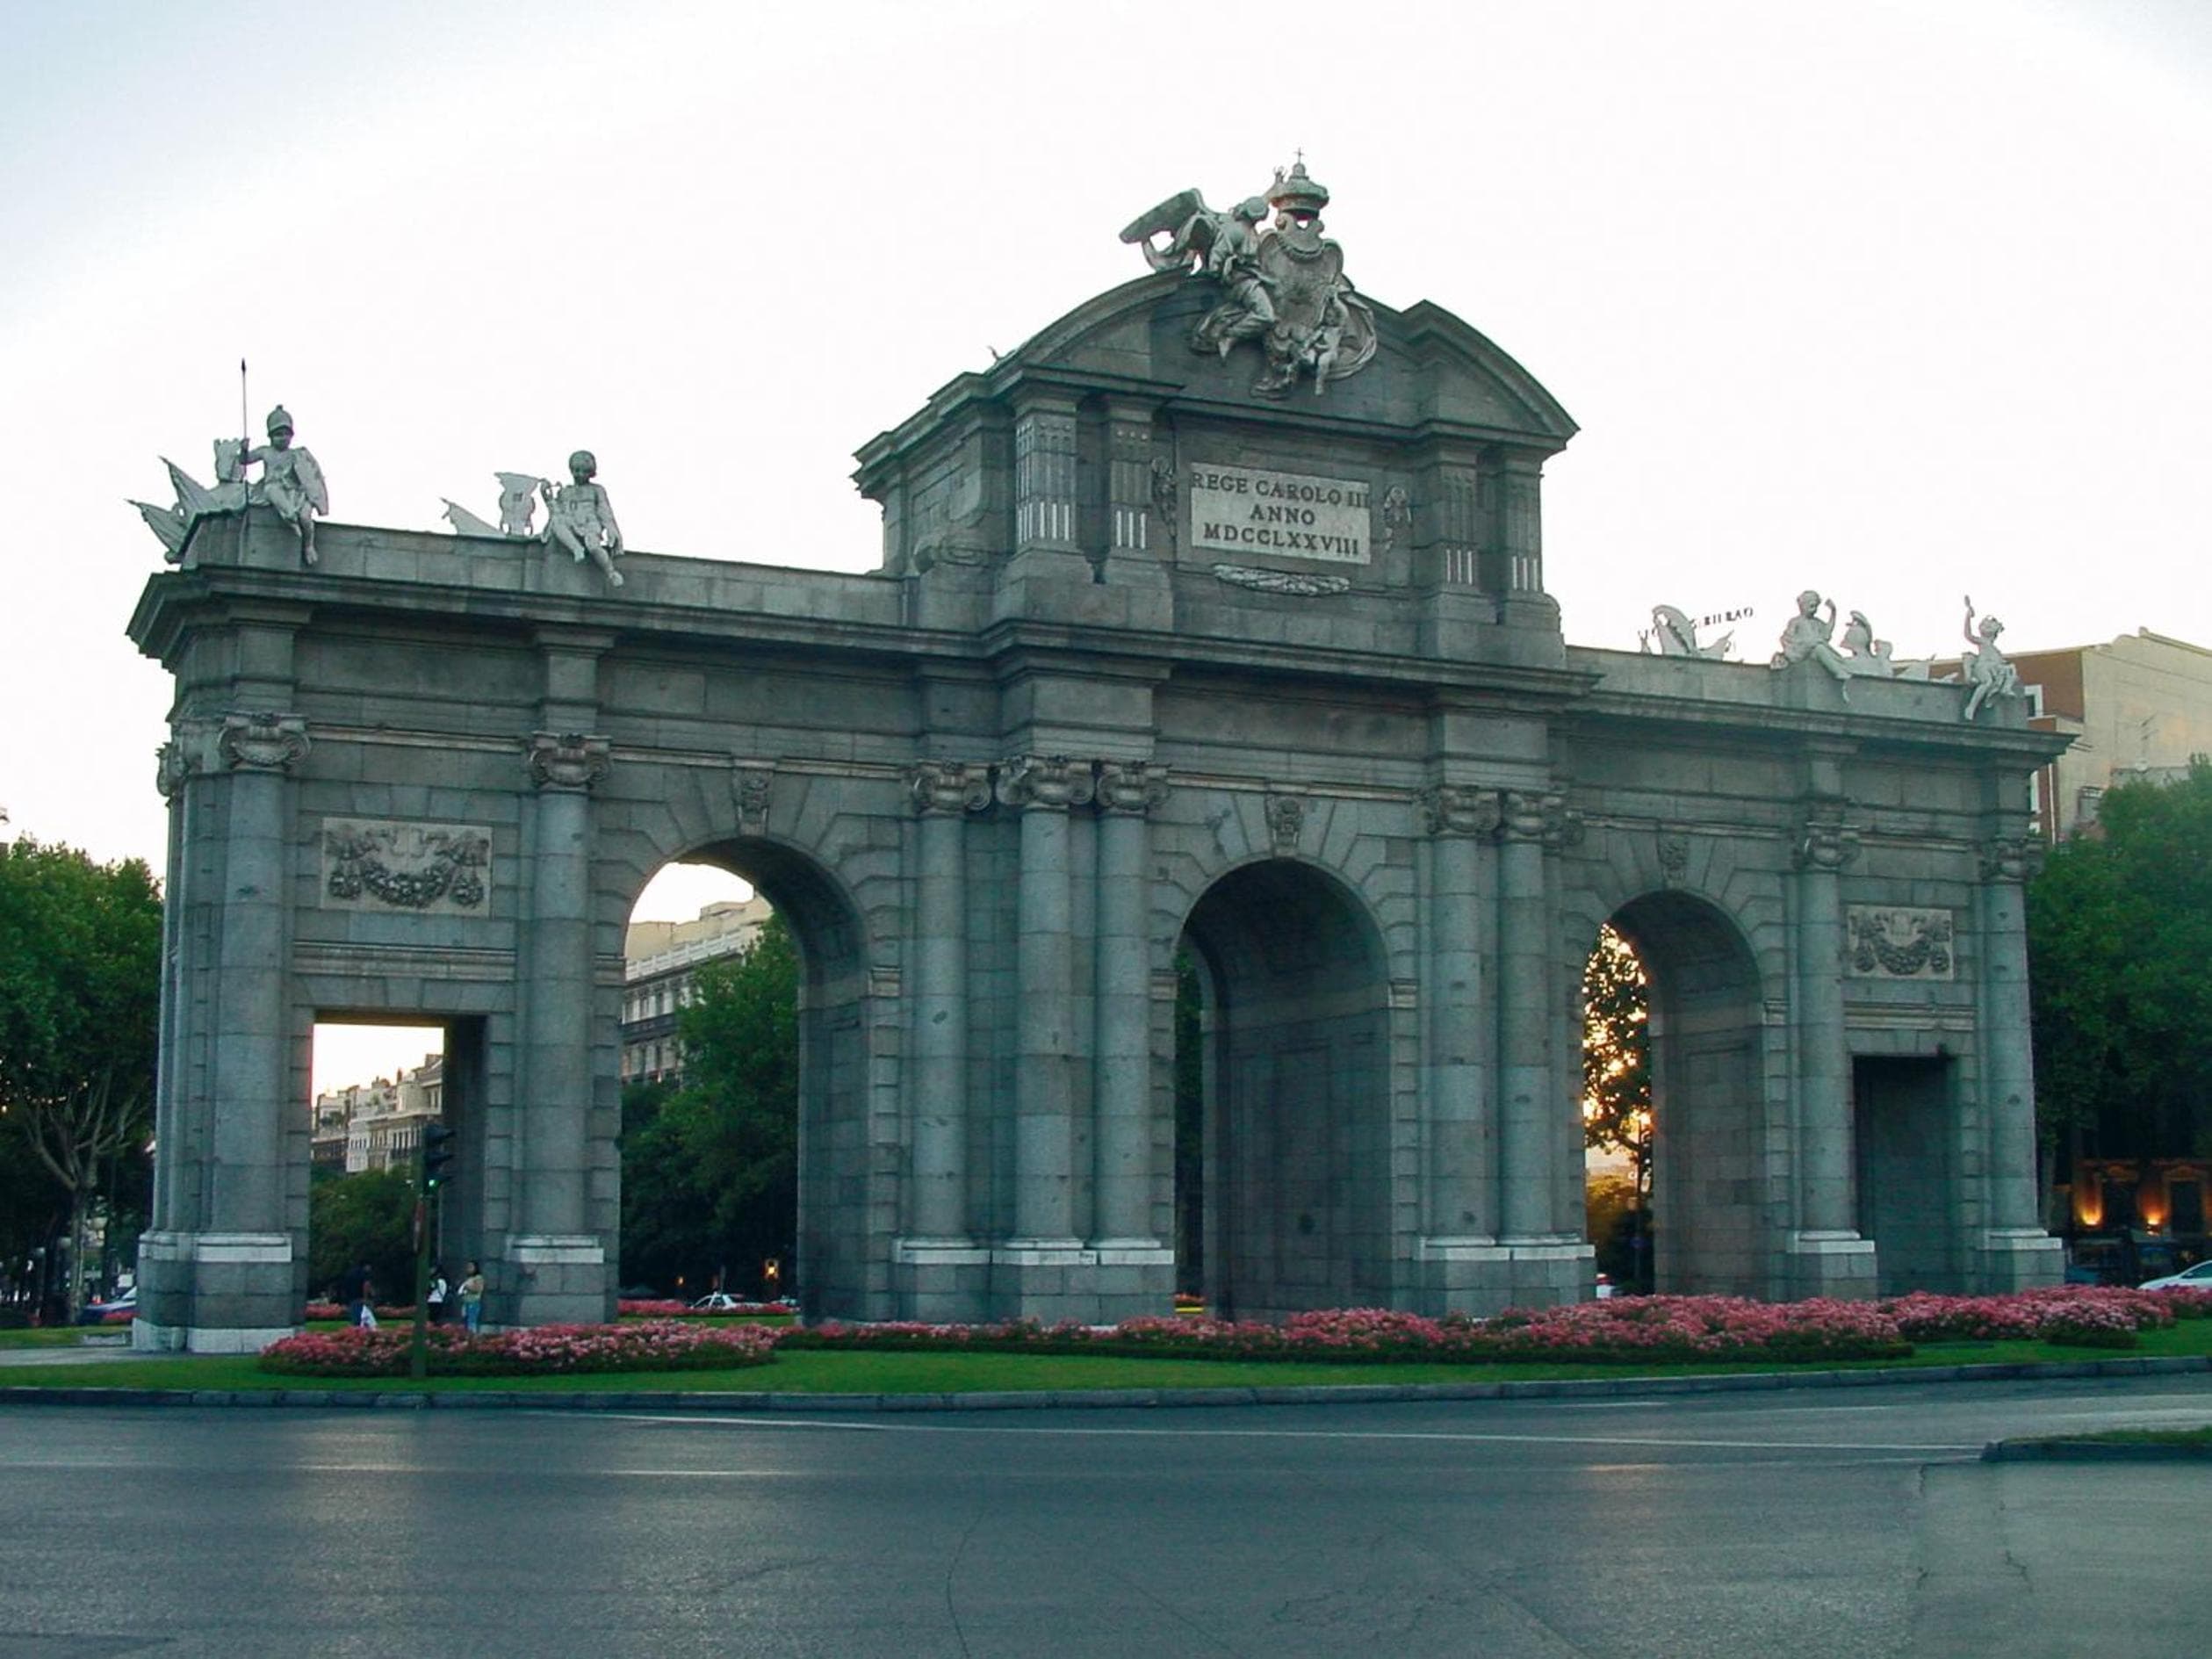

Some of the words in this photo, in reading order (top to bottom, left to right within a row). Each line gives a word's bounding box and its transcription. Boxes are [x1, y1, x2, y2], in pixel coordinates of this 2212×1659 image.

[1190, 472, 1248, 494] REGE
[1256, 480, 1341, 505] CAROLO
[1347, 491, 1371, 509] III
[1250, 503, 1315, 525] ANNO
[1204, 522, 1358, 555] MDCCLXXVIII
